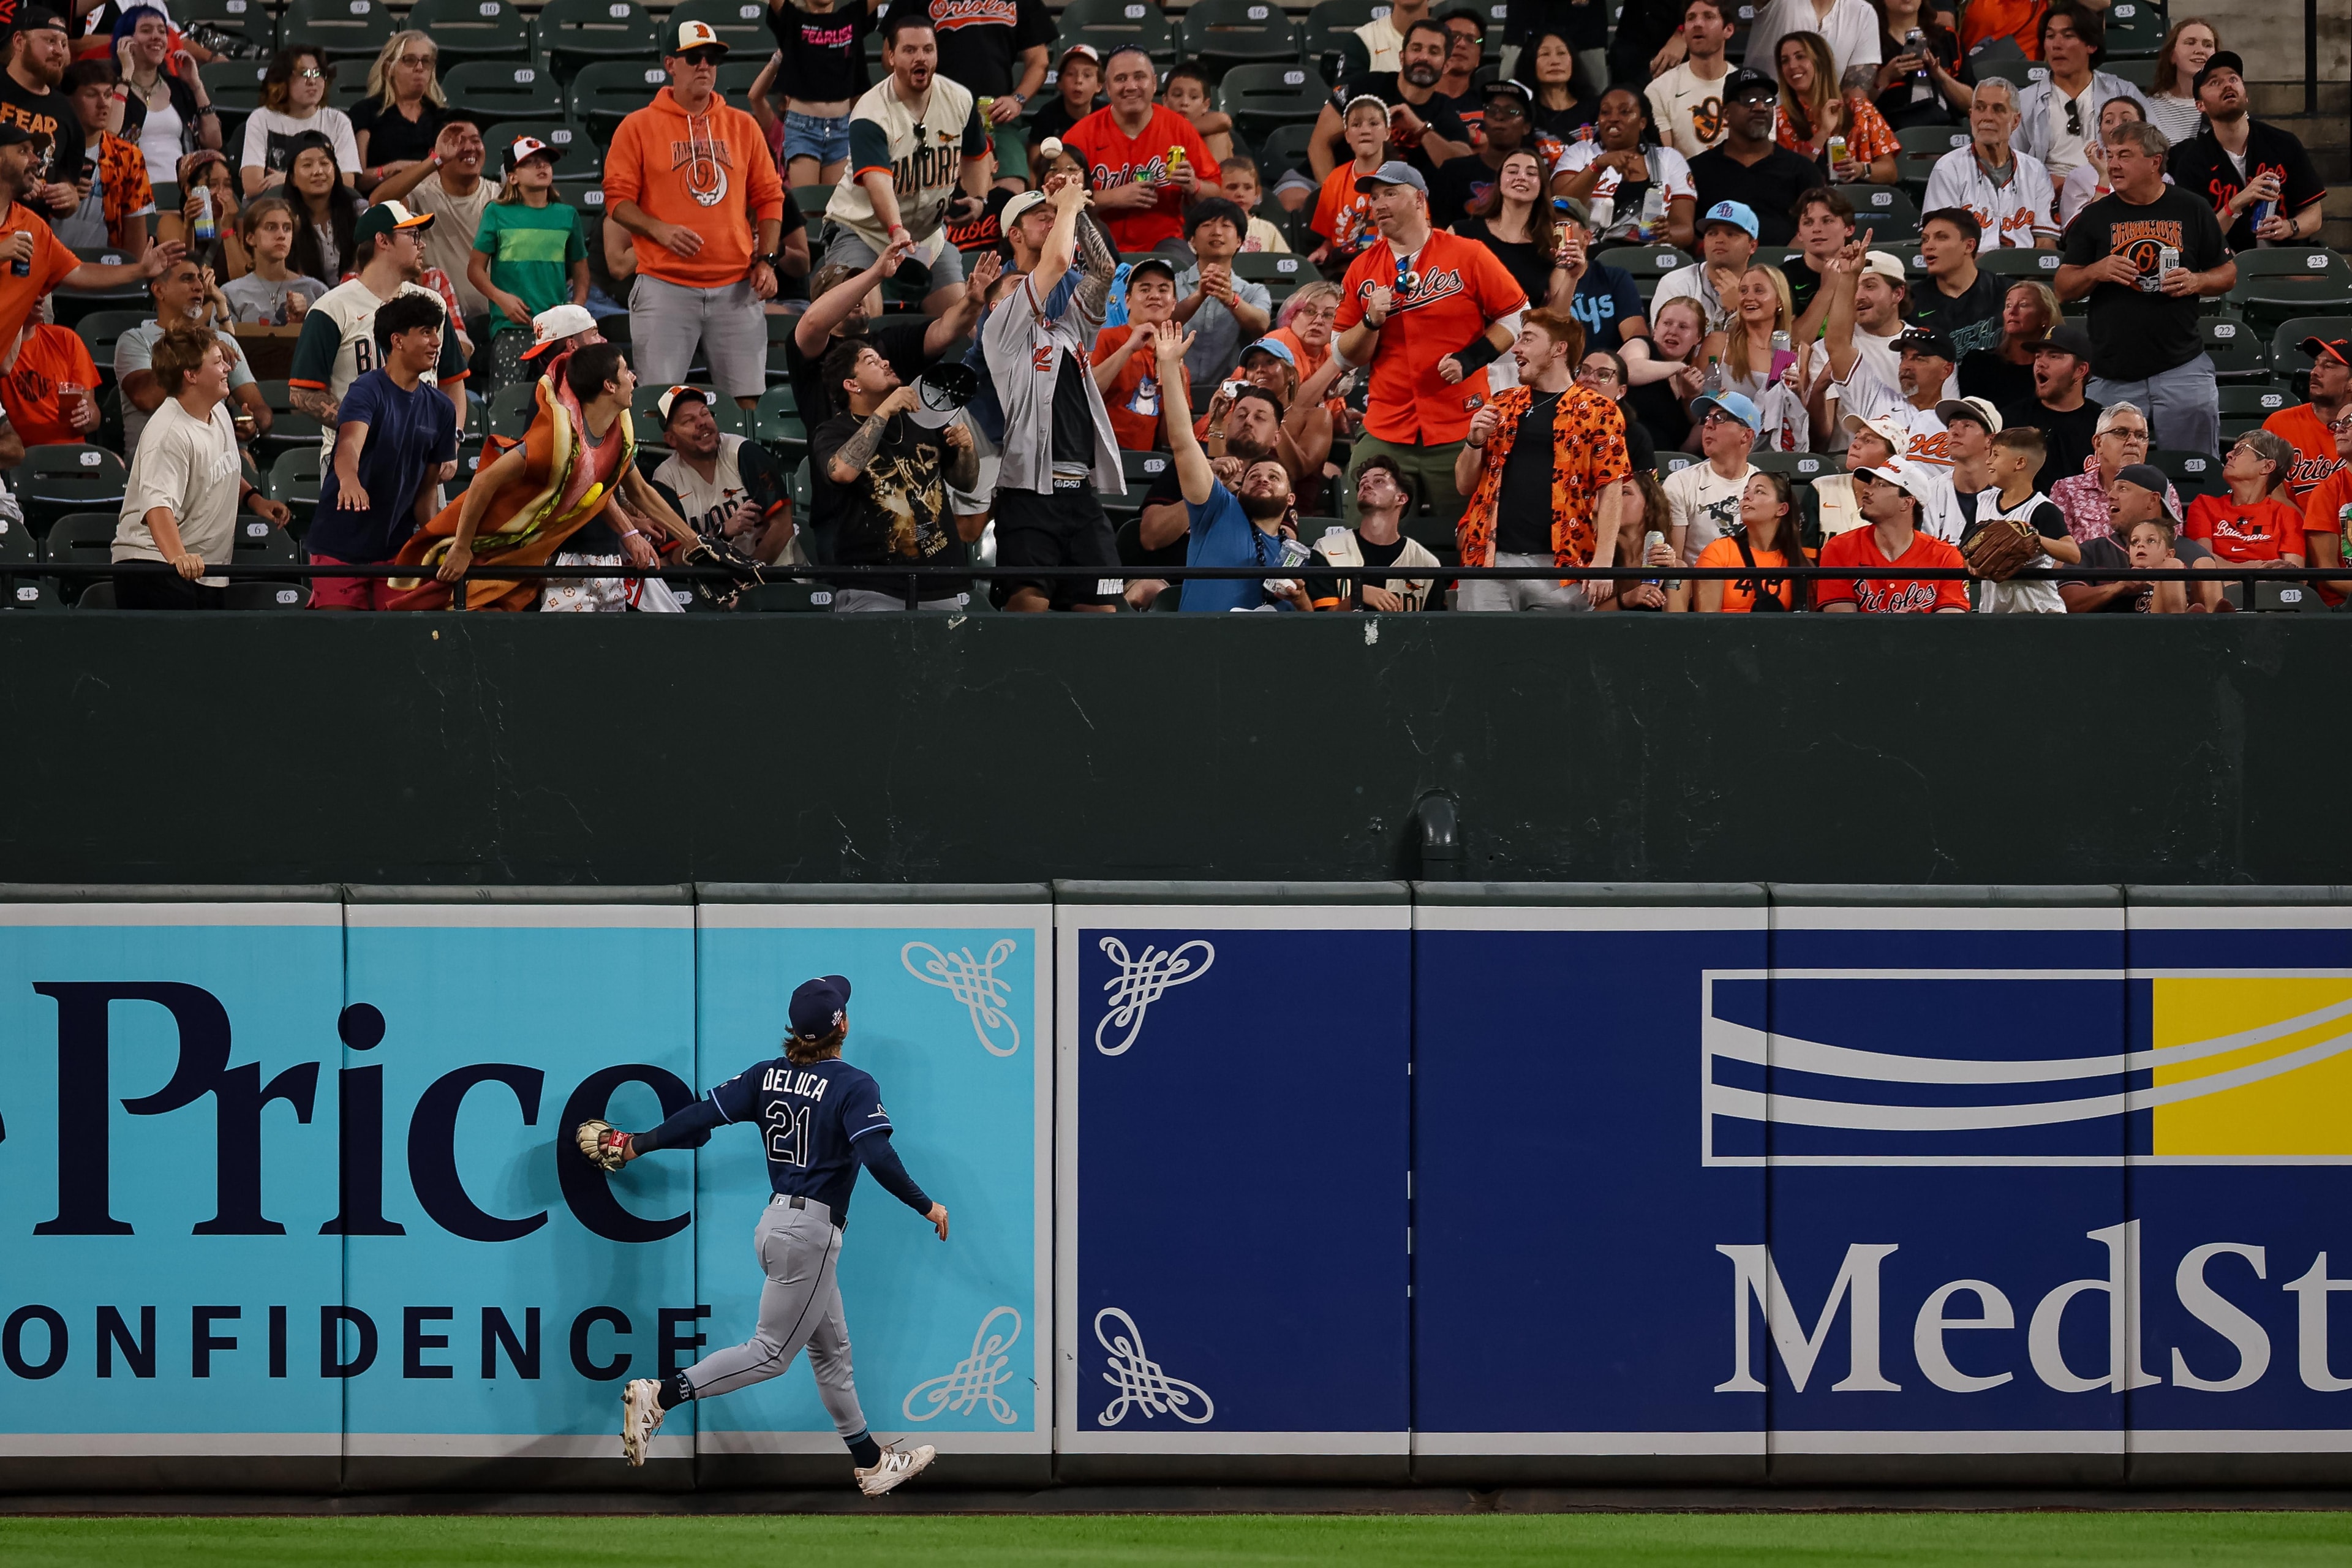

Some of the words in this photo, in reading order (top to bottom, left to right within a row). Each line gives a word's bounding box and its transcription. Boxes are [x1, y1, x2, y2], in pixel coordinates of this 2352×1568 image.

[615, 6, 625, 15] 11
[2119, 7, 2131, 15] 23
[520, 72, 531, 81] 10
[650, 72, 661, 81] 11
[2032, 70, 2043, 78] 22
[557, 132, 568, 141] 10
[1955, 136, 1965, 145] 21
[589, 194, 601, 203] 10
[1875, 195, 1888, 204] 20
[1282, 261, 1293, 270] 15
[1660, 257, 1673, 266] 18
[2043, 257, 2054, 267] 21
[2311, 257, 2323, 266] 23
[2218, 326, 2231, 336] 22
[2265, 396, 2278, 405] 22
[87, 453, 94, 464] 5
[1149, 461, 1161, 470] 13
[1673, 461, 1684, 470] 17
[1803, 461, 1814, 470] 18
[2188, 461, 2201, 470] 21
[254, 525, 262, 535] 6
[23, 589, 32, 599] 4
[284, 592, 291, 602] 6
[678, 593, 686, 603] 9
[816, 593, 828, 603] 10
[2285, 592, 2297, 601] 21
[763, 1068, 829, 1102] DELUCA
[32, 981, 695, 1244] Price
[766, 1099, 810, 1168] 21
[2, 1304, 711, 1381] ONFIDENCE
